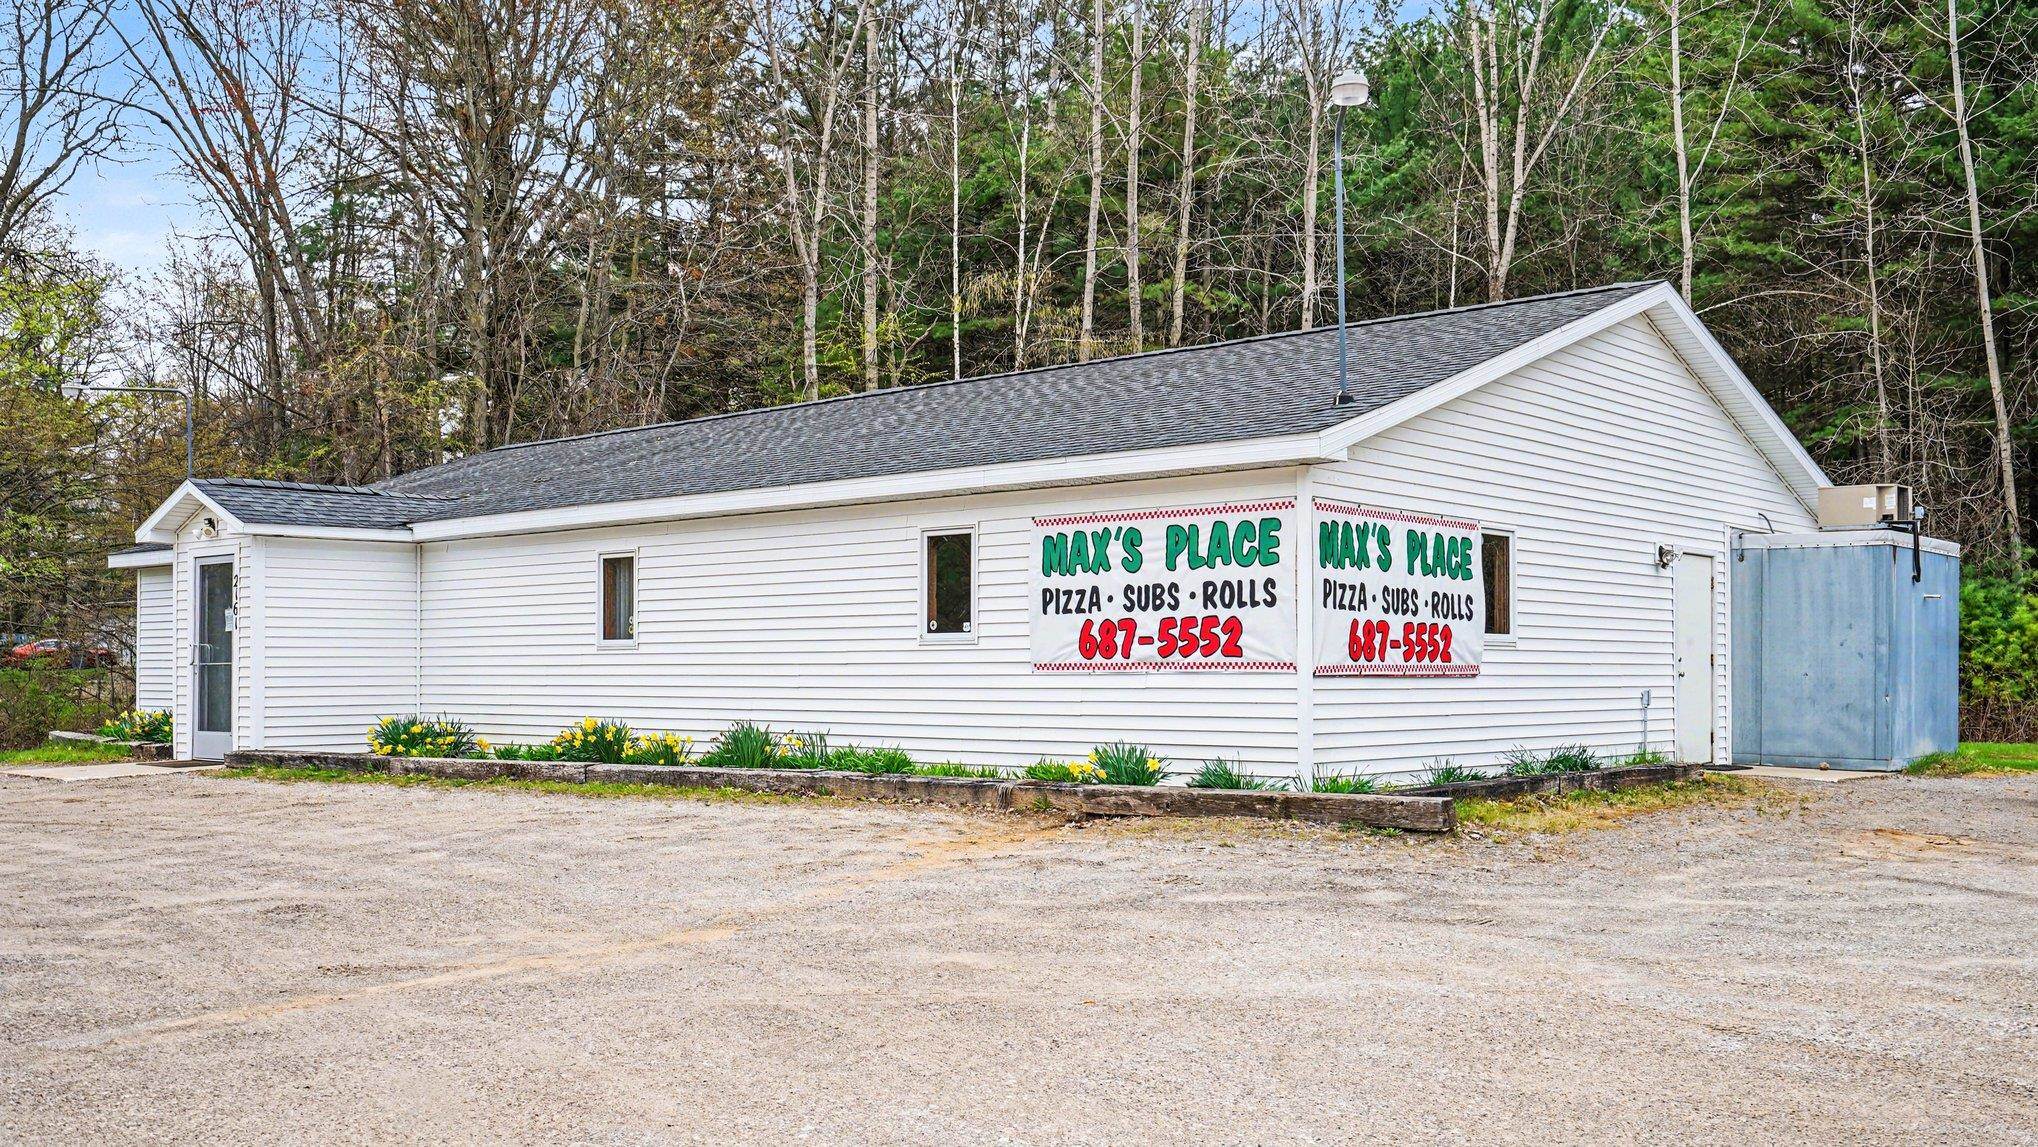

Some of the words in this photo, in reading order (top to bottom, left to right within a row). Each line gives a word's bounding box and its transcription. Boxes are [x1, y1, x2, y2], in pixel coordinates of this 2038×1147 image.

[1041, 526, 1144, 578] MAX'S
[1165, 517, 1282, 572] PLACE
[1319, 520, 1393, 573] MAX'S
[1406, 528, 1474, 582] PLACE
[1041, 586, 1102, 616] PIZZA
[1122, 582, 1181, 613] SUBS
[1202, 577, 1278, 611] ROLLS
[1322, 578, 1368, 613] PIZZA
[1381, 585, 1419, 618] SUBS
[1431, 590, 1474, 622] ROLLS
[1078, 615, 1244, 660] 687-5552
[1347, 618, 1453, 664] 687-5552
